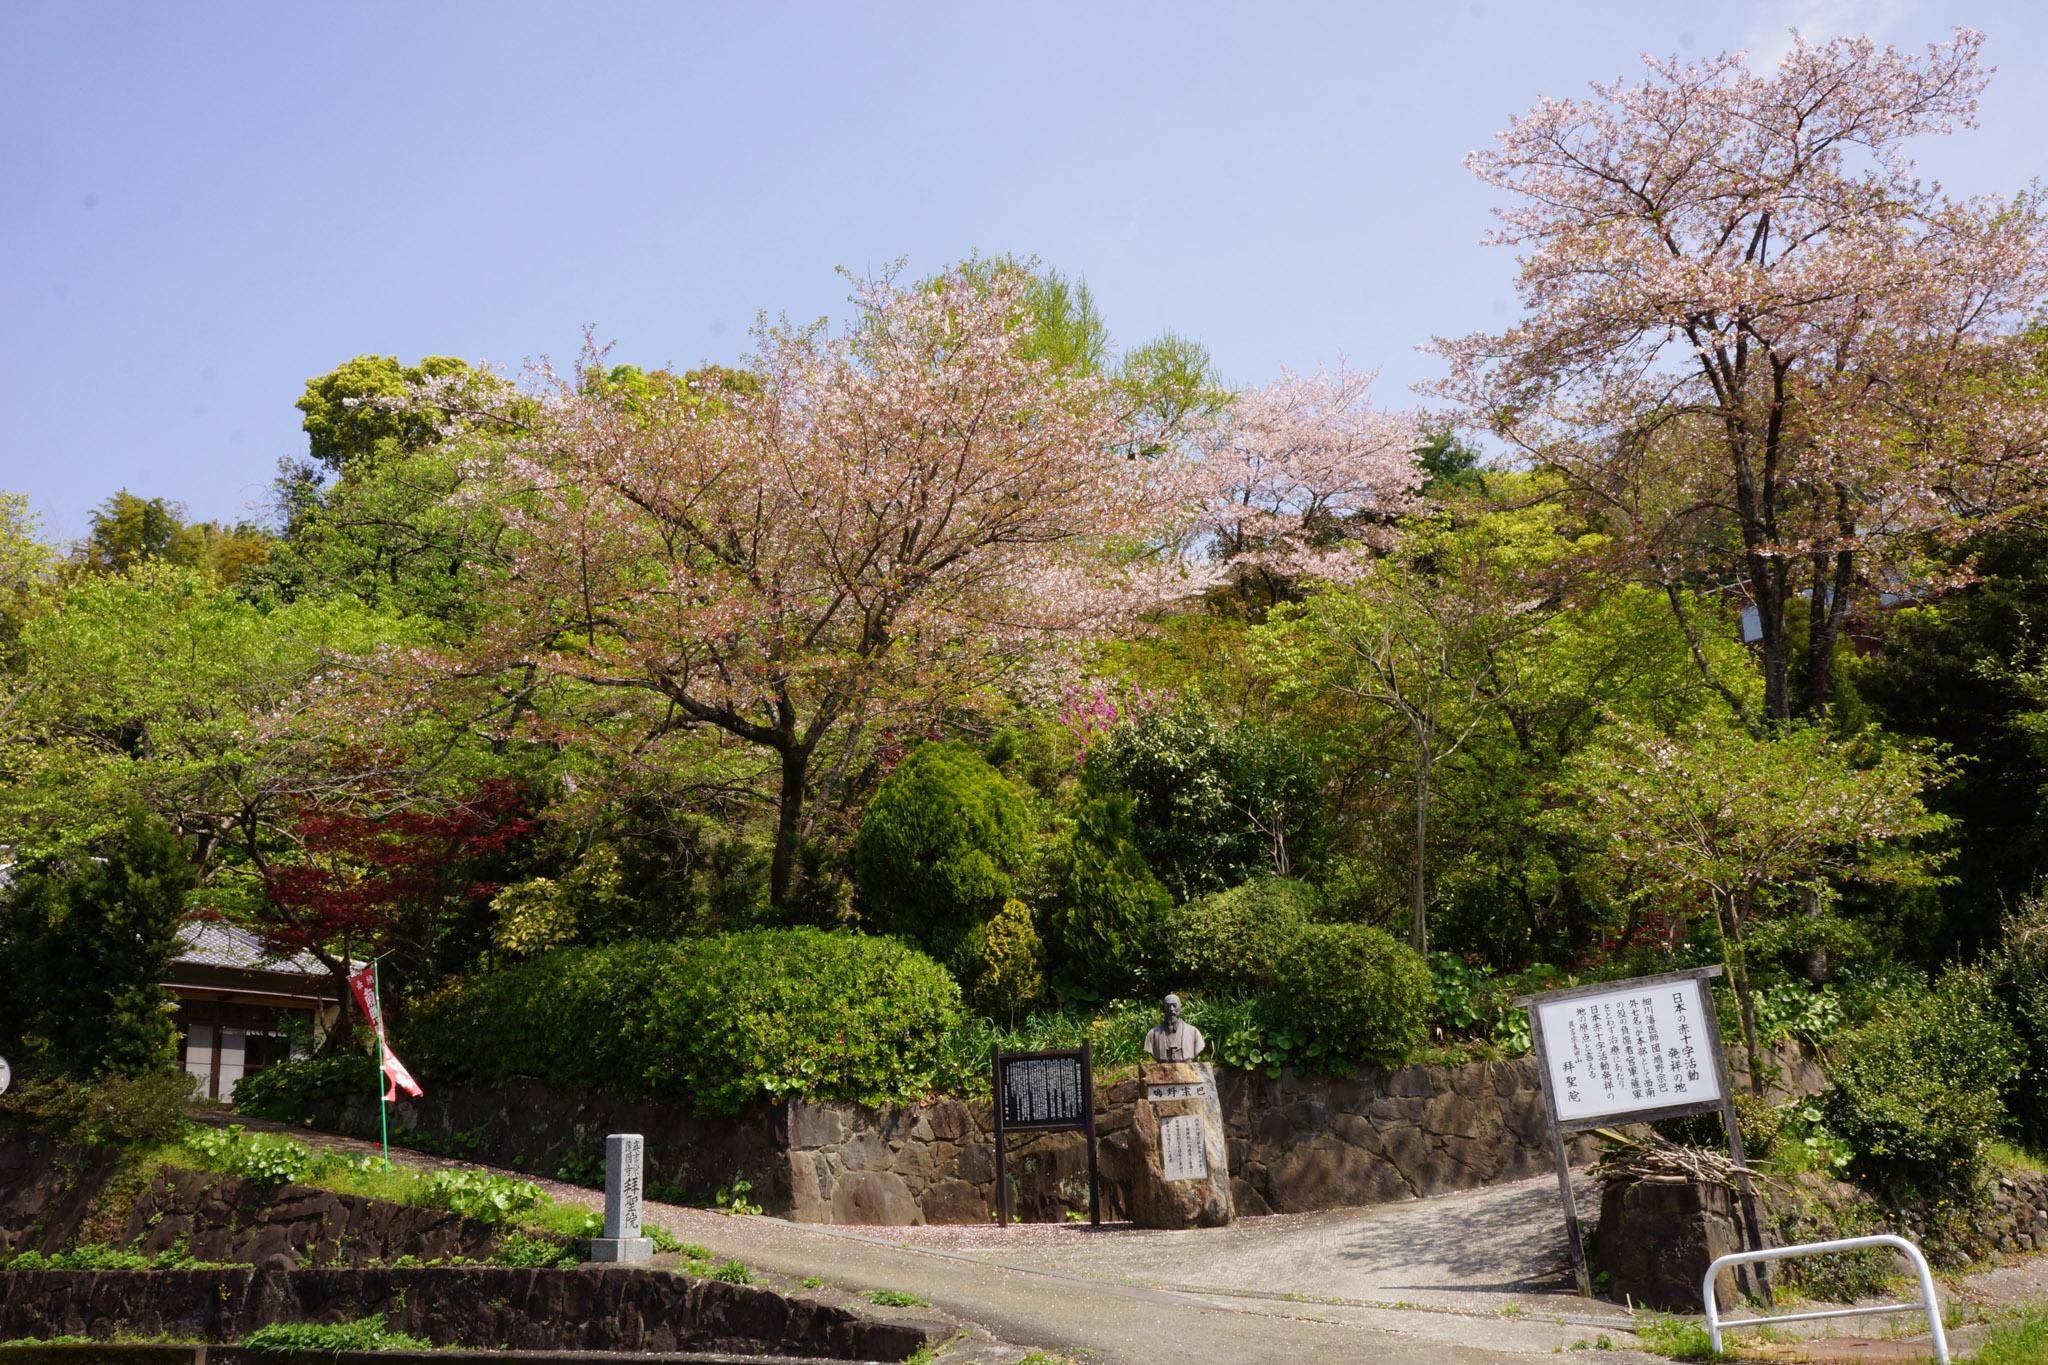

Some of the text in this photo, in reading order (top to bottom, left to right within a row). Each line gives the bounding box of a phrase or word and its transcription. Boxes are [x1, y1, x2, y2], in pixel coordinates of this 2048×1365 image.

[1576, 1008, 1597, 1079] 地の原点と言える
[1590, 1005, 1615, 1100] 日本赤十字活動発祥の
[1668, 1048, 1687, 1093] 発祥の地
[1672, 992, 1699, 1082] 日本の赤十字活動
[623, 1176, 639, 1229] 拝聖院
